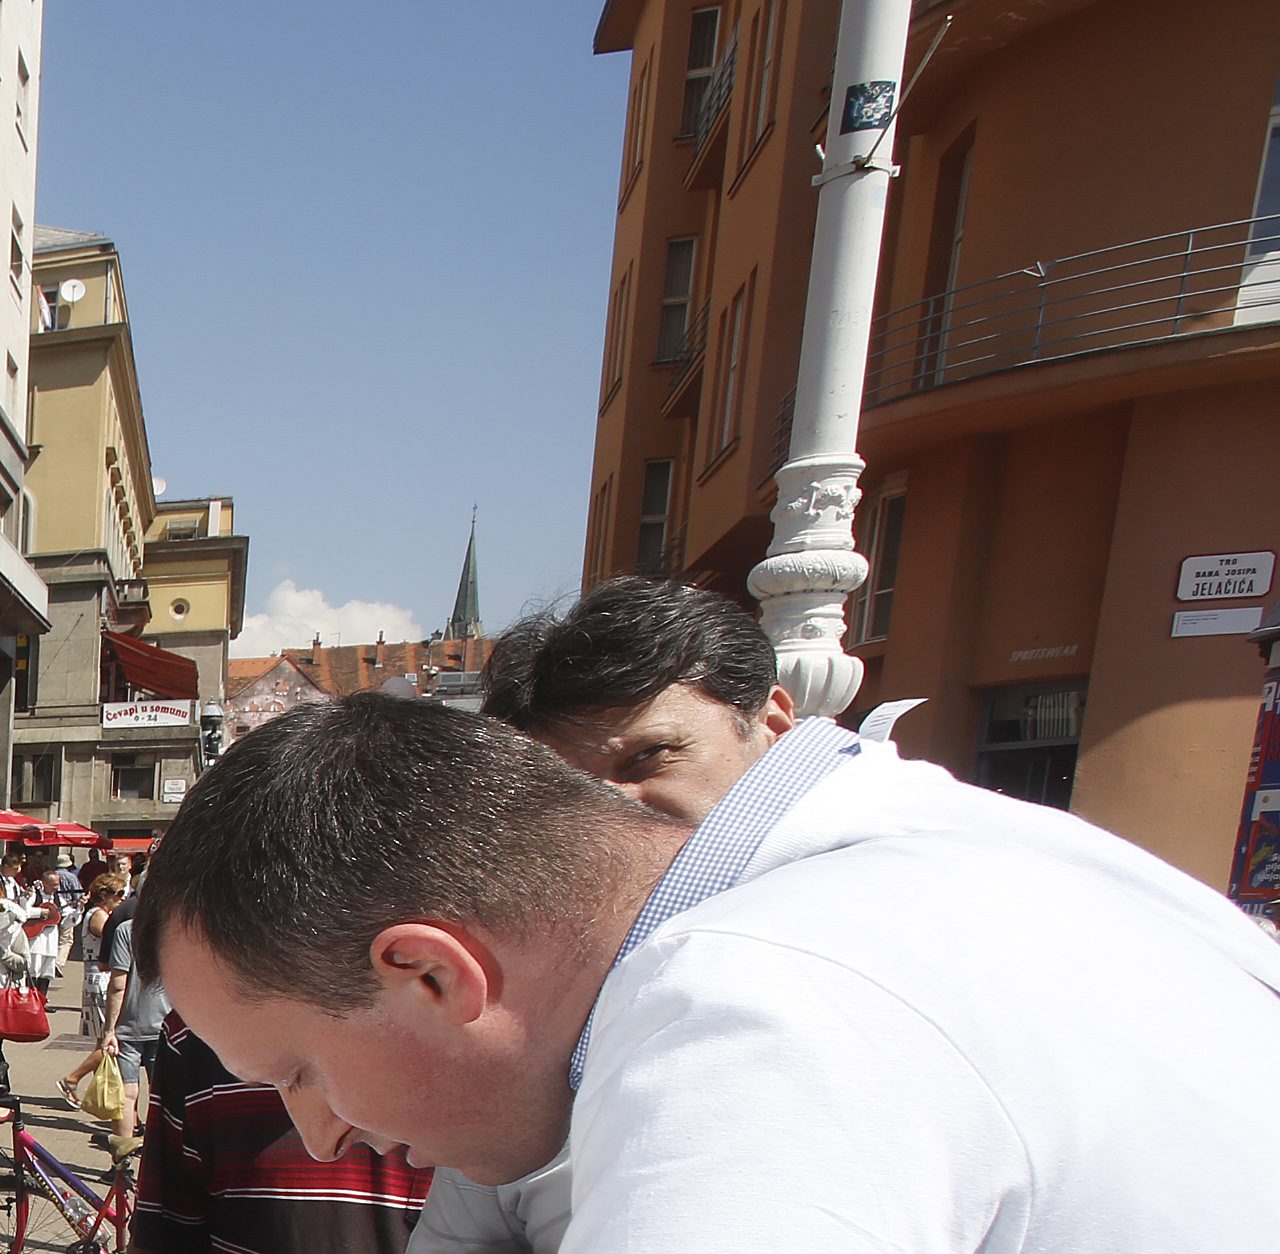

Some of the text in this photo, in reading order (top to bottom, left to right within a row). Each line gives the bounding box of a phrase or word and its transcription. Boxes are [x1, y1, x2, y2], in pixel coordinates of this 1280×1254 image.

[1218, 558, 1238, 566] TRG
[1195, 567, 1257, 578] BANA JOSIPA
[1191, 577, 1255, 597] JELAČIĆA
[104, 704, 139, 721] Čevapi
[149, 704, 189, 719] somunu
